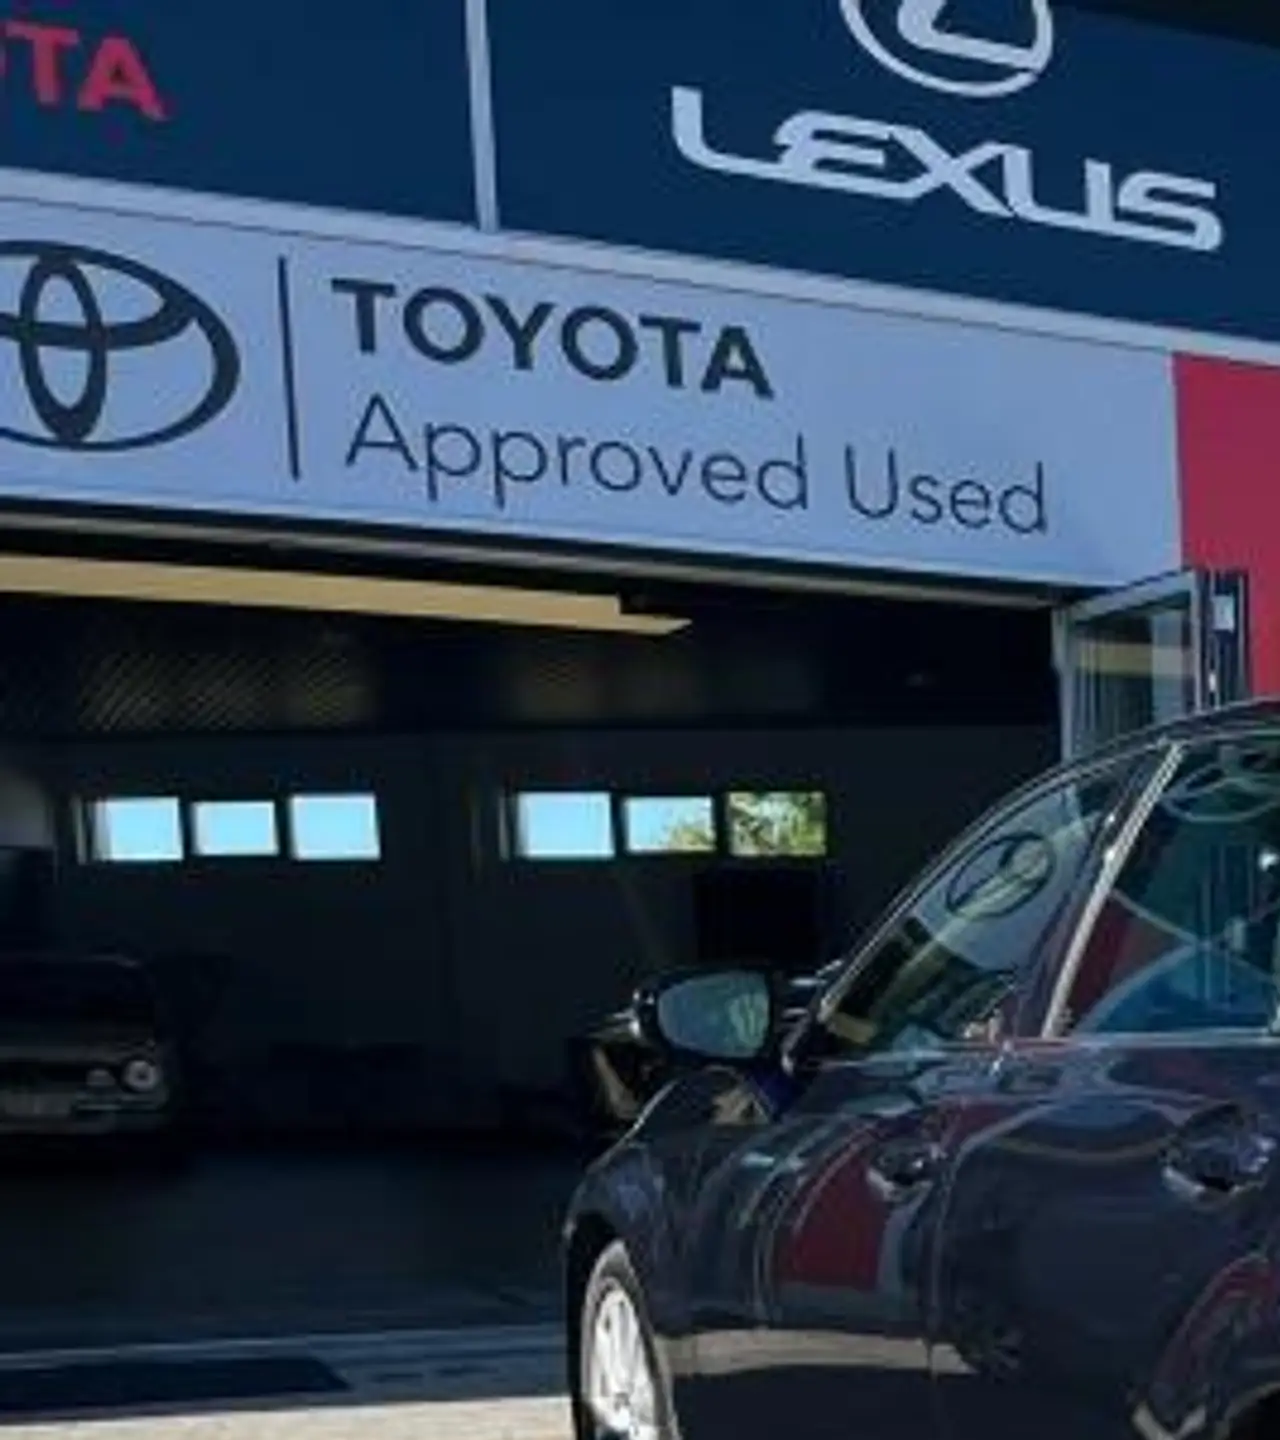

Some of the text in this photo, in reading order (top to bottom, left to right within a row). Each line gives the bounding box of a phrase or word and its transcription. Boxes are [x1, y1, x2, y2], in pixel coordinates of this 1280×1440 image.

[0, 20, 168, 121] TA
[671, 86, 1221, 252] LEXUS
[332, 277, 774, 401] TOYOTA
[345, 393, 1046, 536] Approved Used
